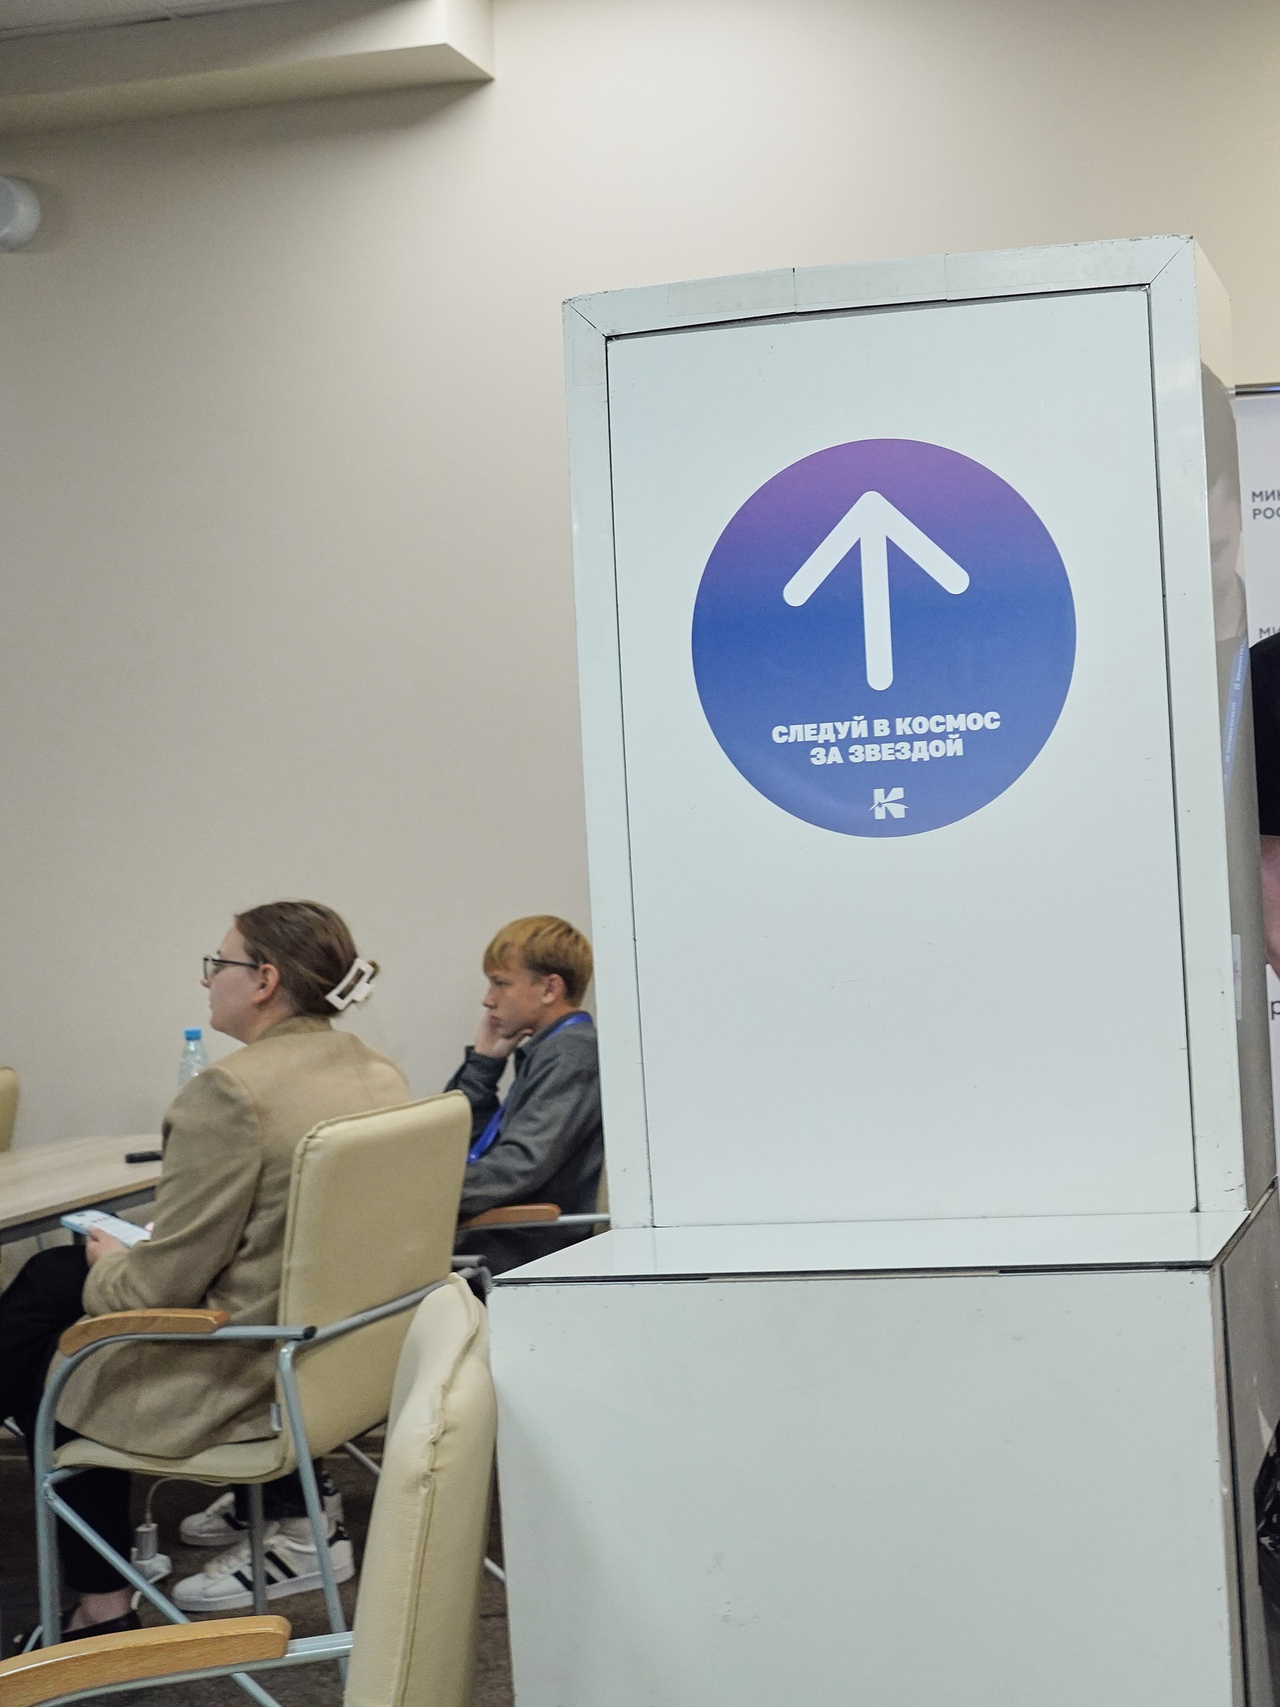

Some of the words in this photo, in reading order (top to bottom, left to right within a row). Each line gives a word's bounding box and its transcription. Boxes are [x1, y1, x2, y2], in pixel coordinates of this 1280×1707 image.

[772, 715, 868, 743] СЛЕДУЙ
[873, 719, 890, 737] В
[895, 711, 1001, 736] КОСМОС
[810, 746, 844, 766] ЗА
[848, 733, 964, 763] ЗВЕЗДОЙ
